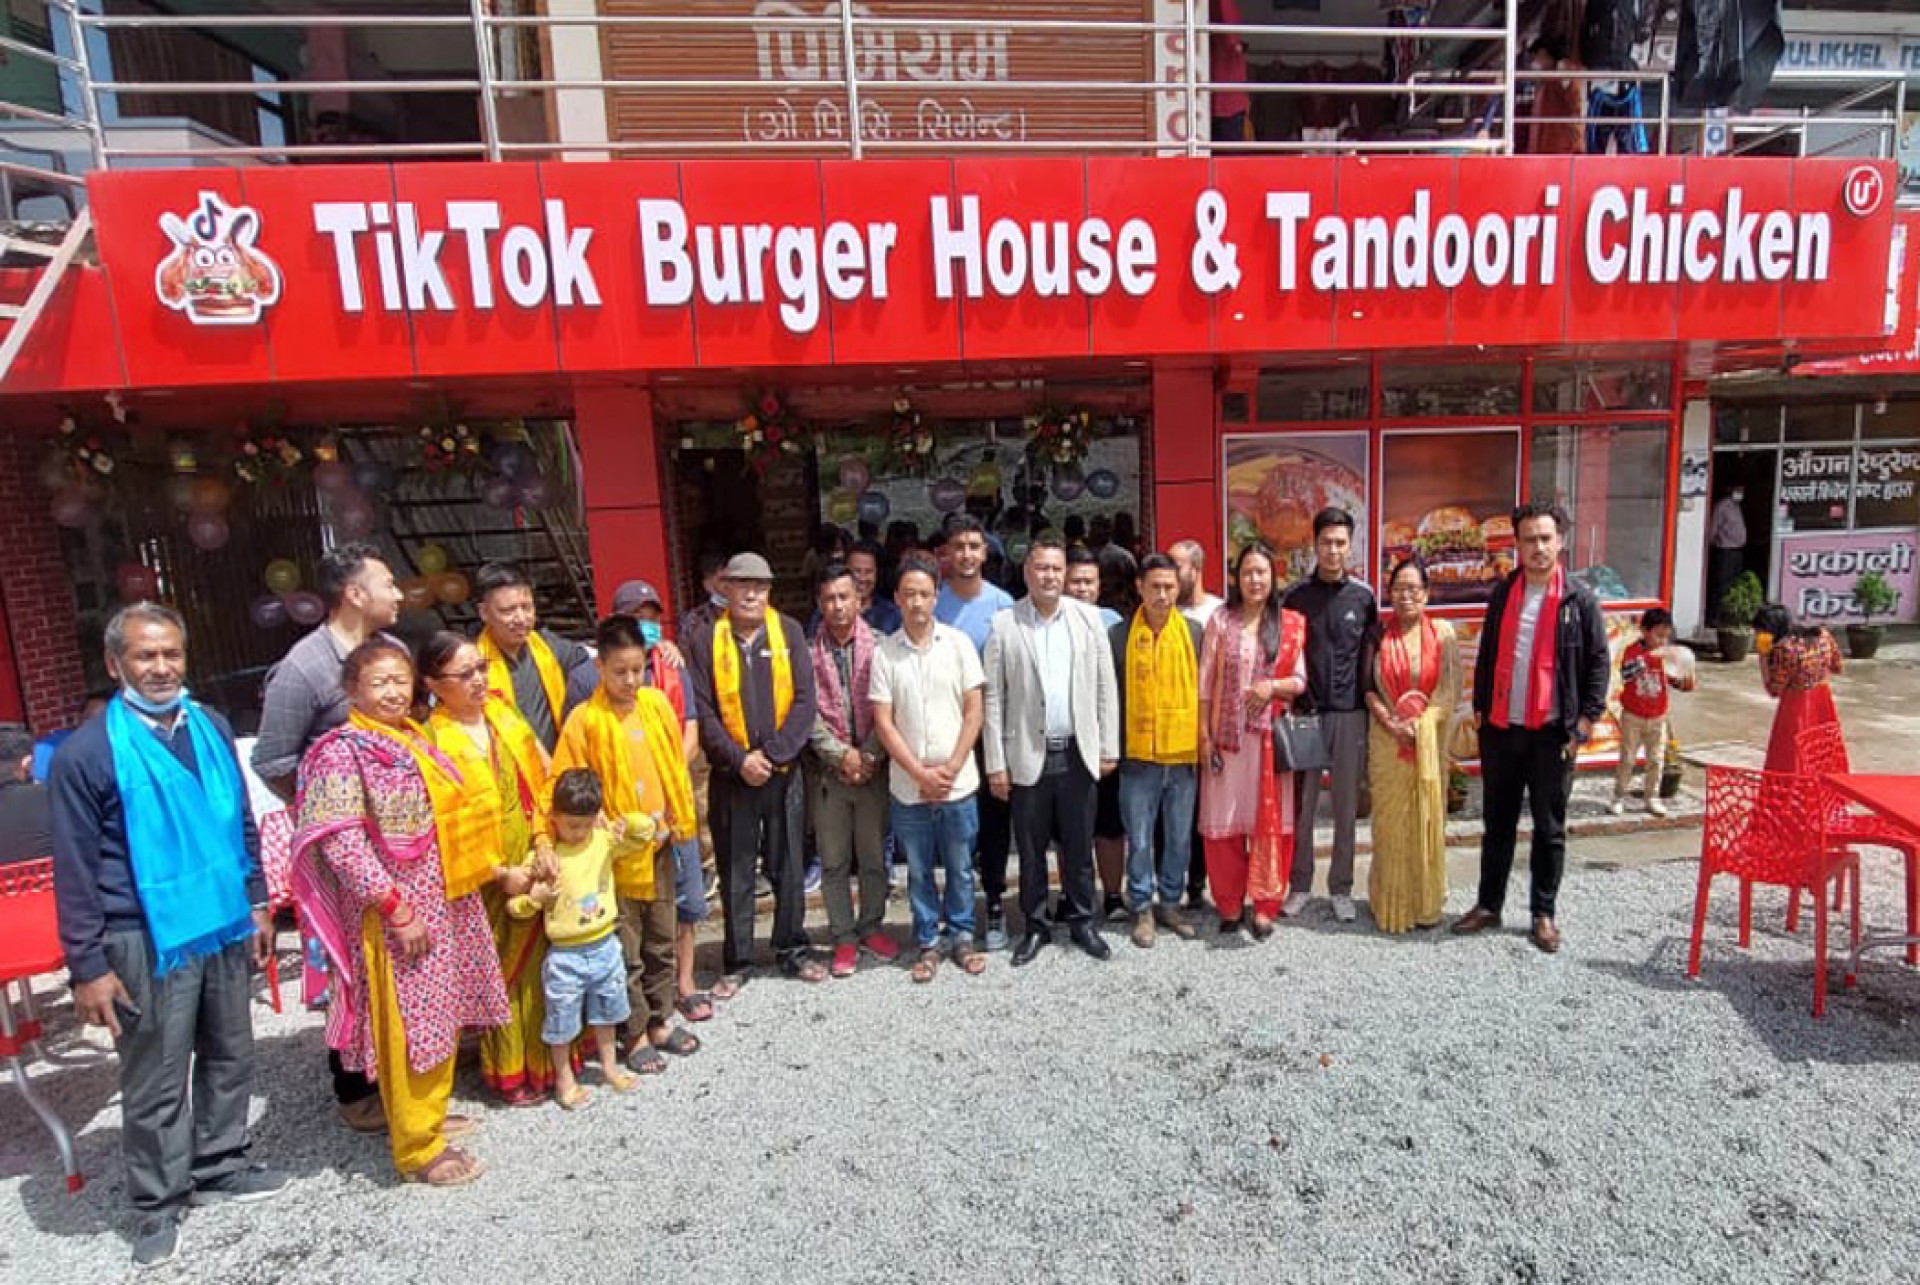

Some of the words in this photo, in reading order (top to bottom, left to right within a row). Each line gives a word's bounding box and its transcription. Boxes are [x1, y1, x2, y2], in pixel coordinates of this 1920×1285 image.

[313, 199, 603, 312] TikTok
[638, 198, 897, 334] Burger
[929, 195, 1158, 299] House
[1192, 189, 1241, 294] &
[1265, 185, 1560, 291] Tandoori
[1585, 184, 1831, 284] Chicken
